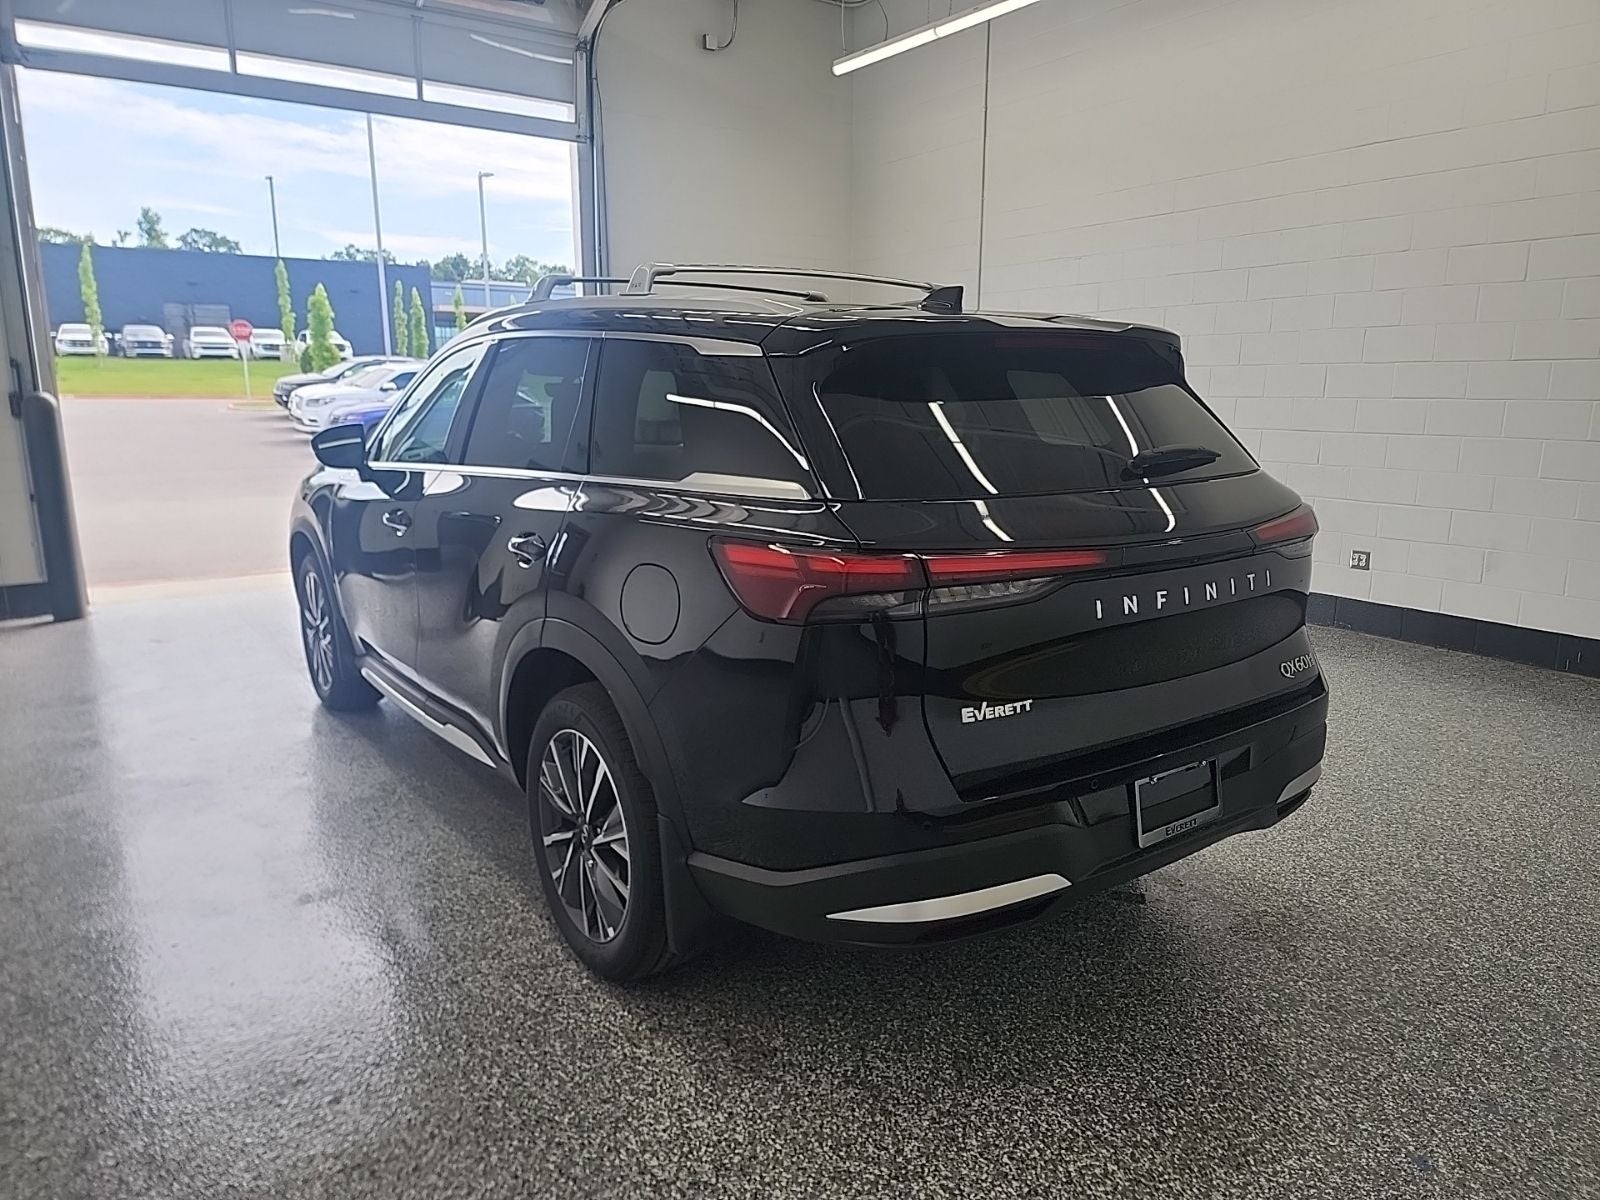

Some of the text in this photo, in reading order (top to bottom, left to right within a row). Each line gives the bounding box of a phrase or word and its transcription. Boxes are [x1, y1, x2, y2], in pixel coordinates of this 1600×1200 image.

[1095, 569, 1273, 619] INFINITI
[961, 699, 1033, 723] EVERETT
[1165, 818, 1198, 837] EVERETT
